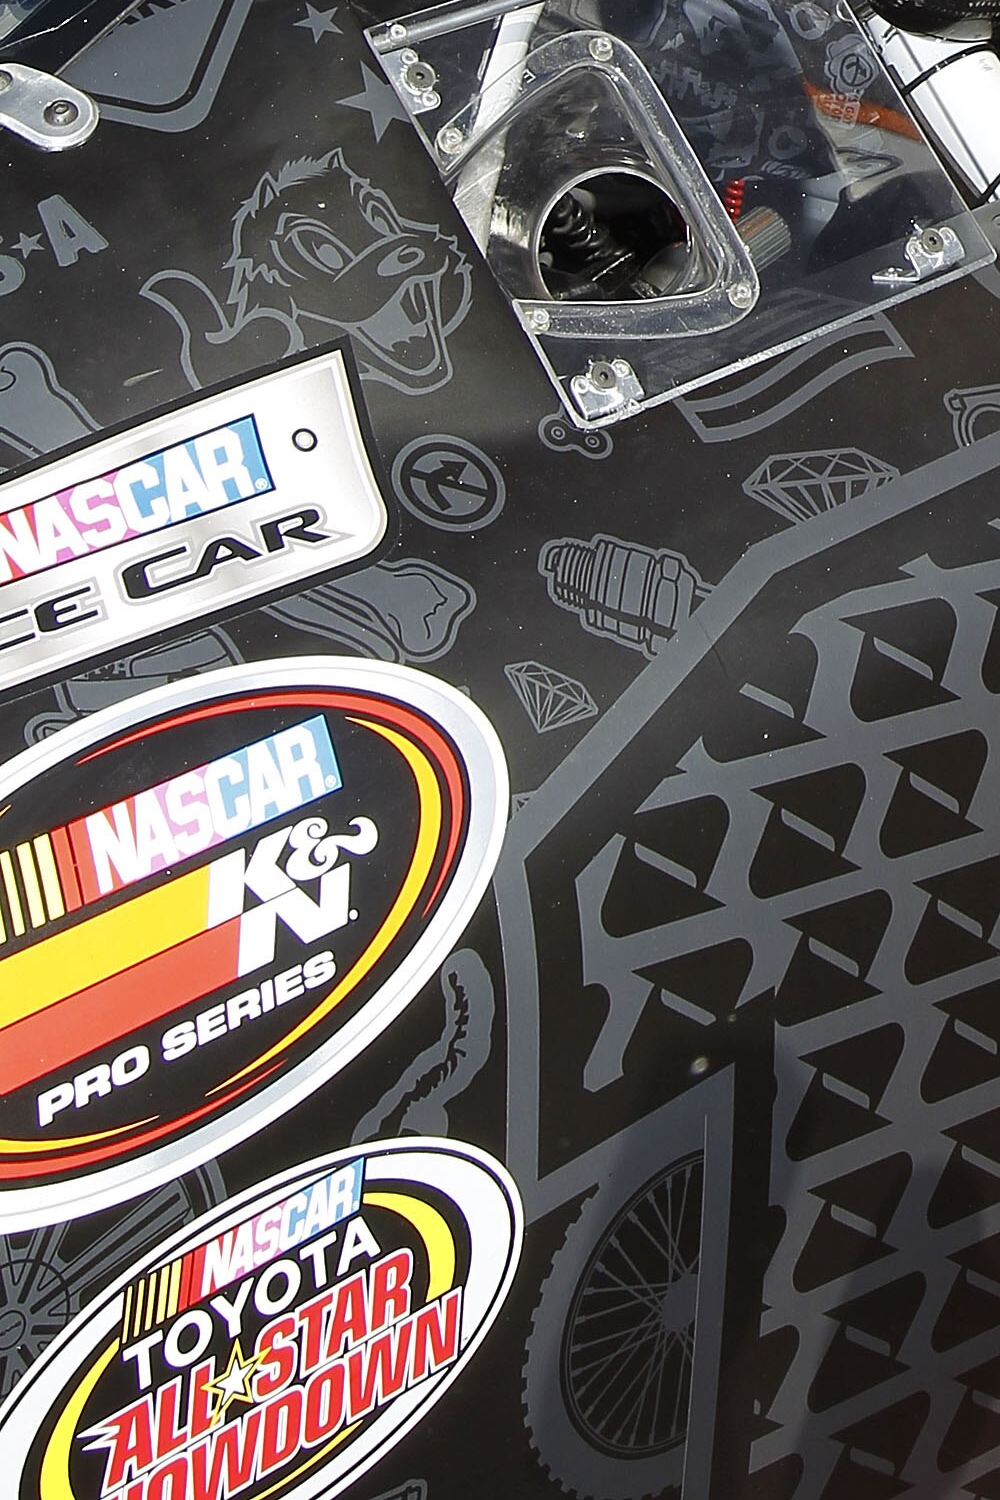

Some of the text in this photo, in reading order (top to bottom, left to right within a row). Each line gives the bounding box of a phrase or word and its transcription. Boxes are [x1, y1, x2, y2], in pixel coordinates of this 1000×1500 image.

[121, 508, 332, 599] CAR
[84, 724, 330, 898] NASCAR
[37, 950, 337, 1128] PRO SERIES
[121, 1214, 382, 1391] TOYOTA
[200, 1165, 359, 1297] NASCAR
[253, 1246, 414, 1403] STAR
